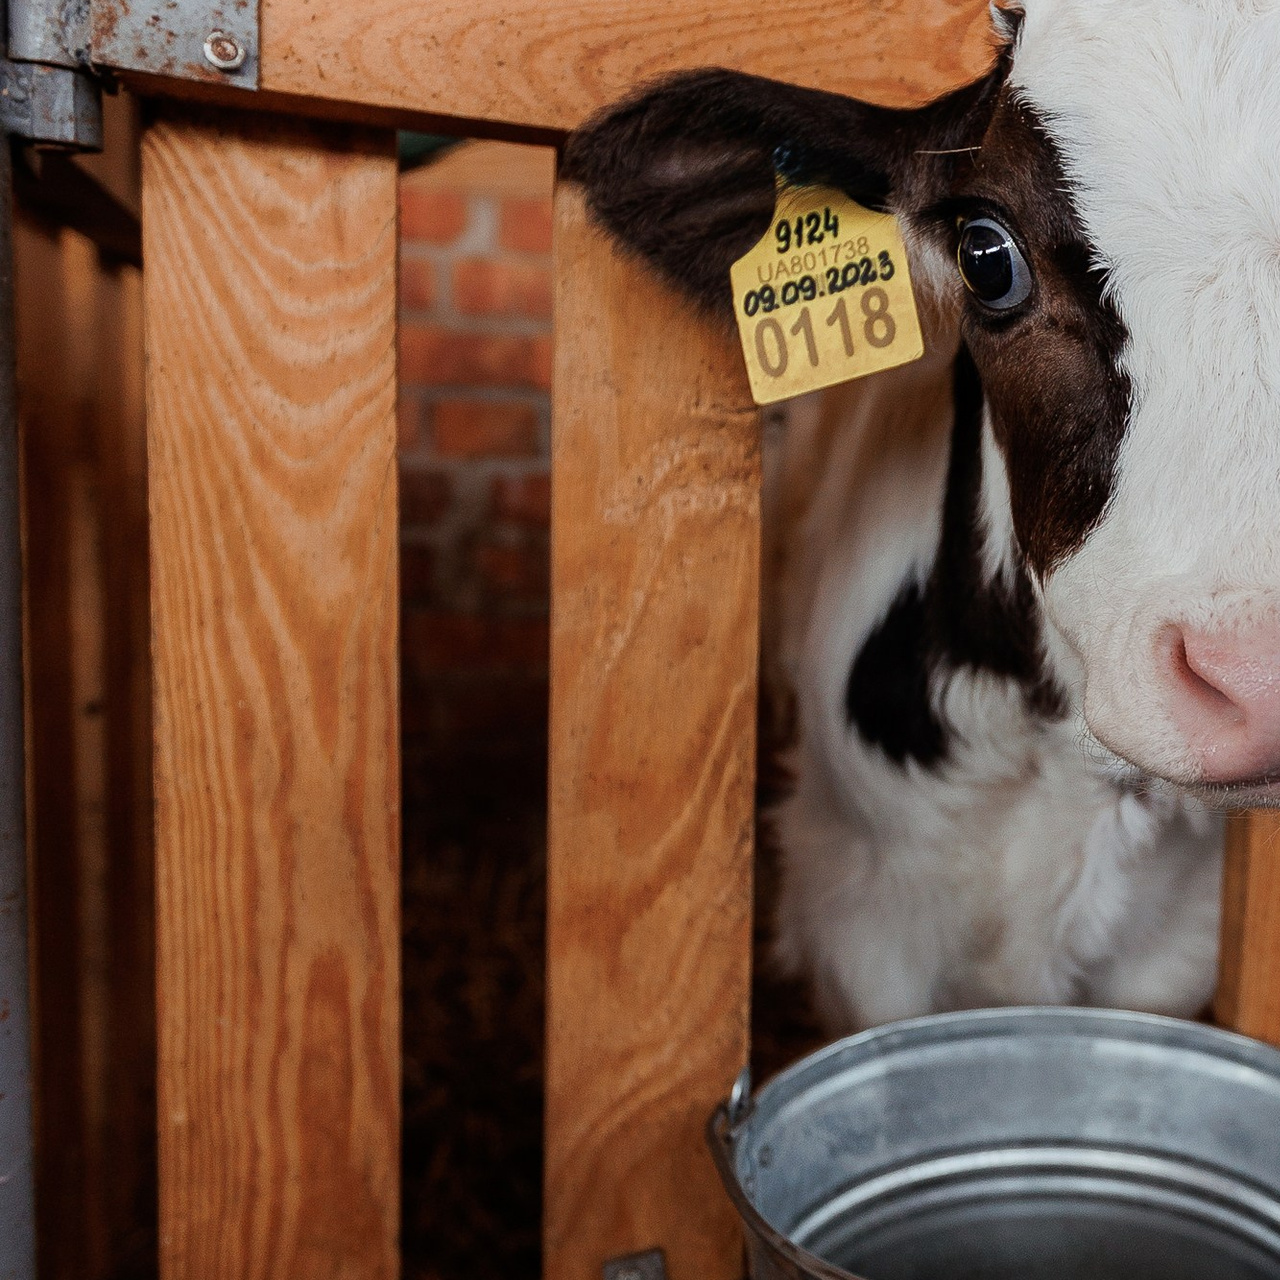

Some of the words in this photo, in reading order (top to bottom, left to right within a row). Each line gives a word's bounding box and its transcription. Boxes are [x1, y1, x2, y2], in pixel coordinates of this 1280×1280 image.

[775, 207, 839, 254] 9124
[744, 250, 895, 317] 09.09.2023
[757, 236, 870, 283] UA801738
[755, 287, 896, 377] 0118
